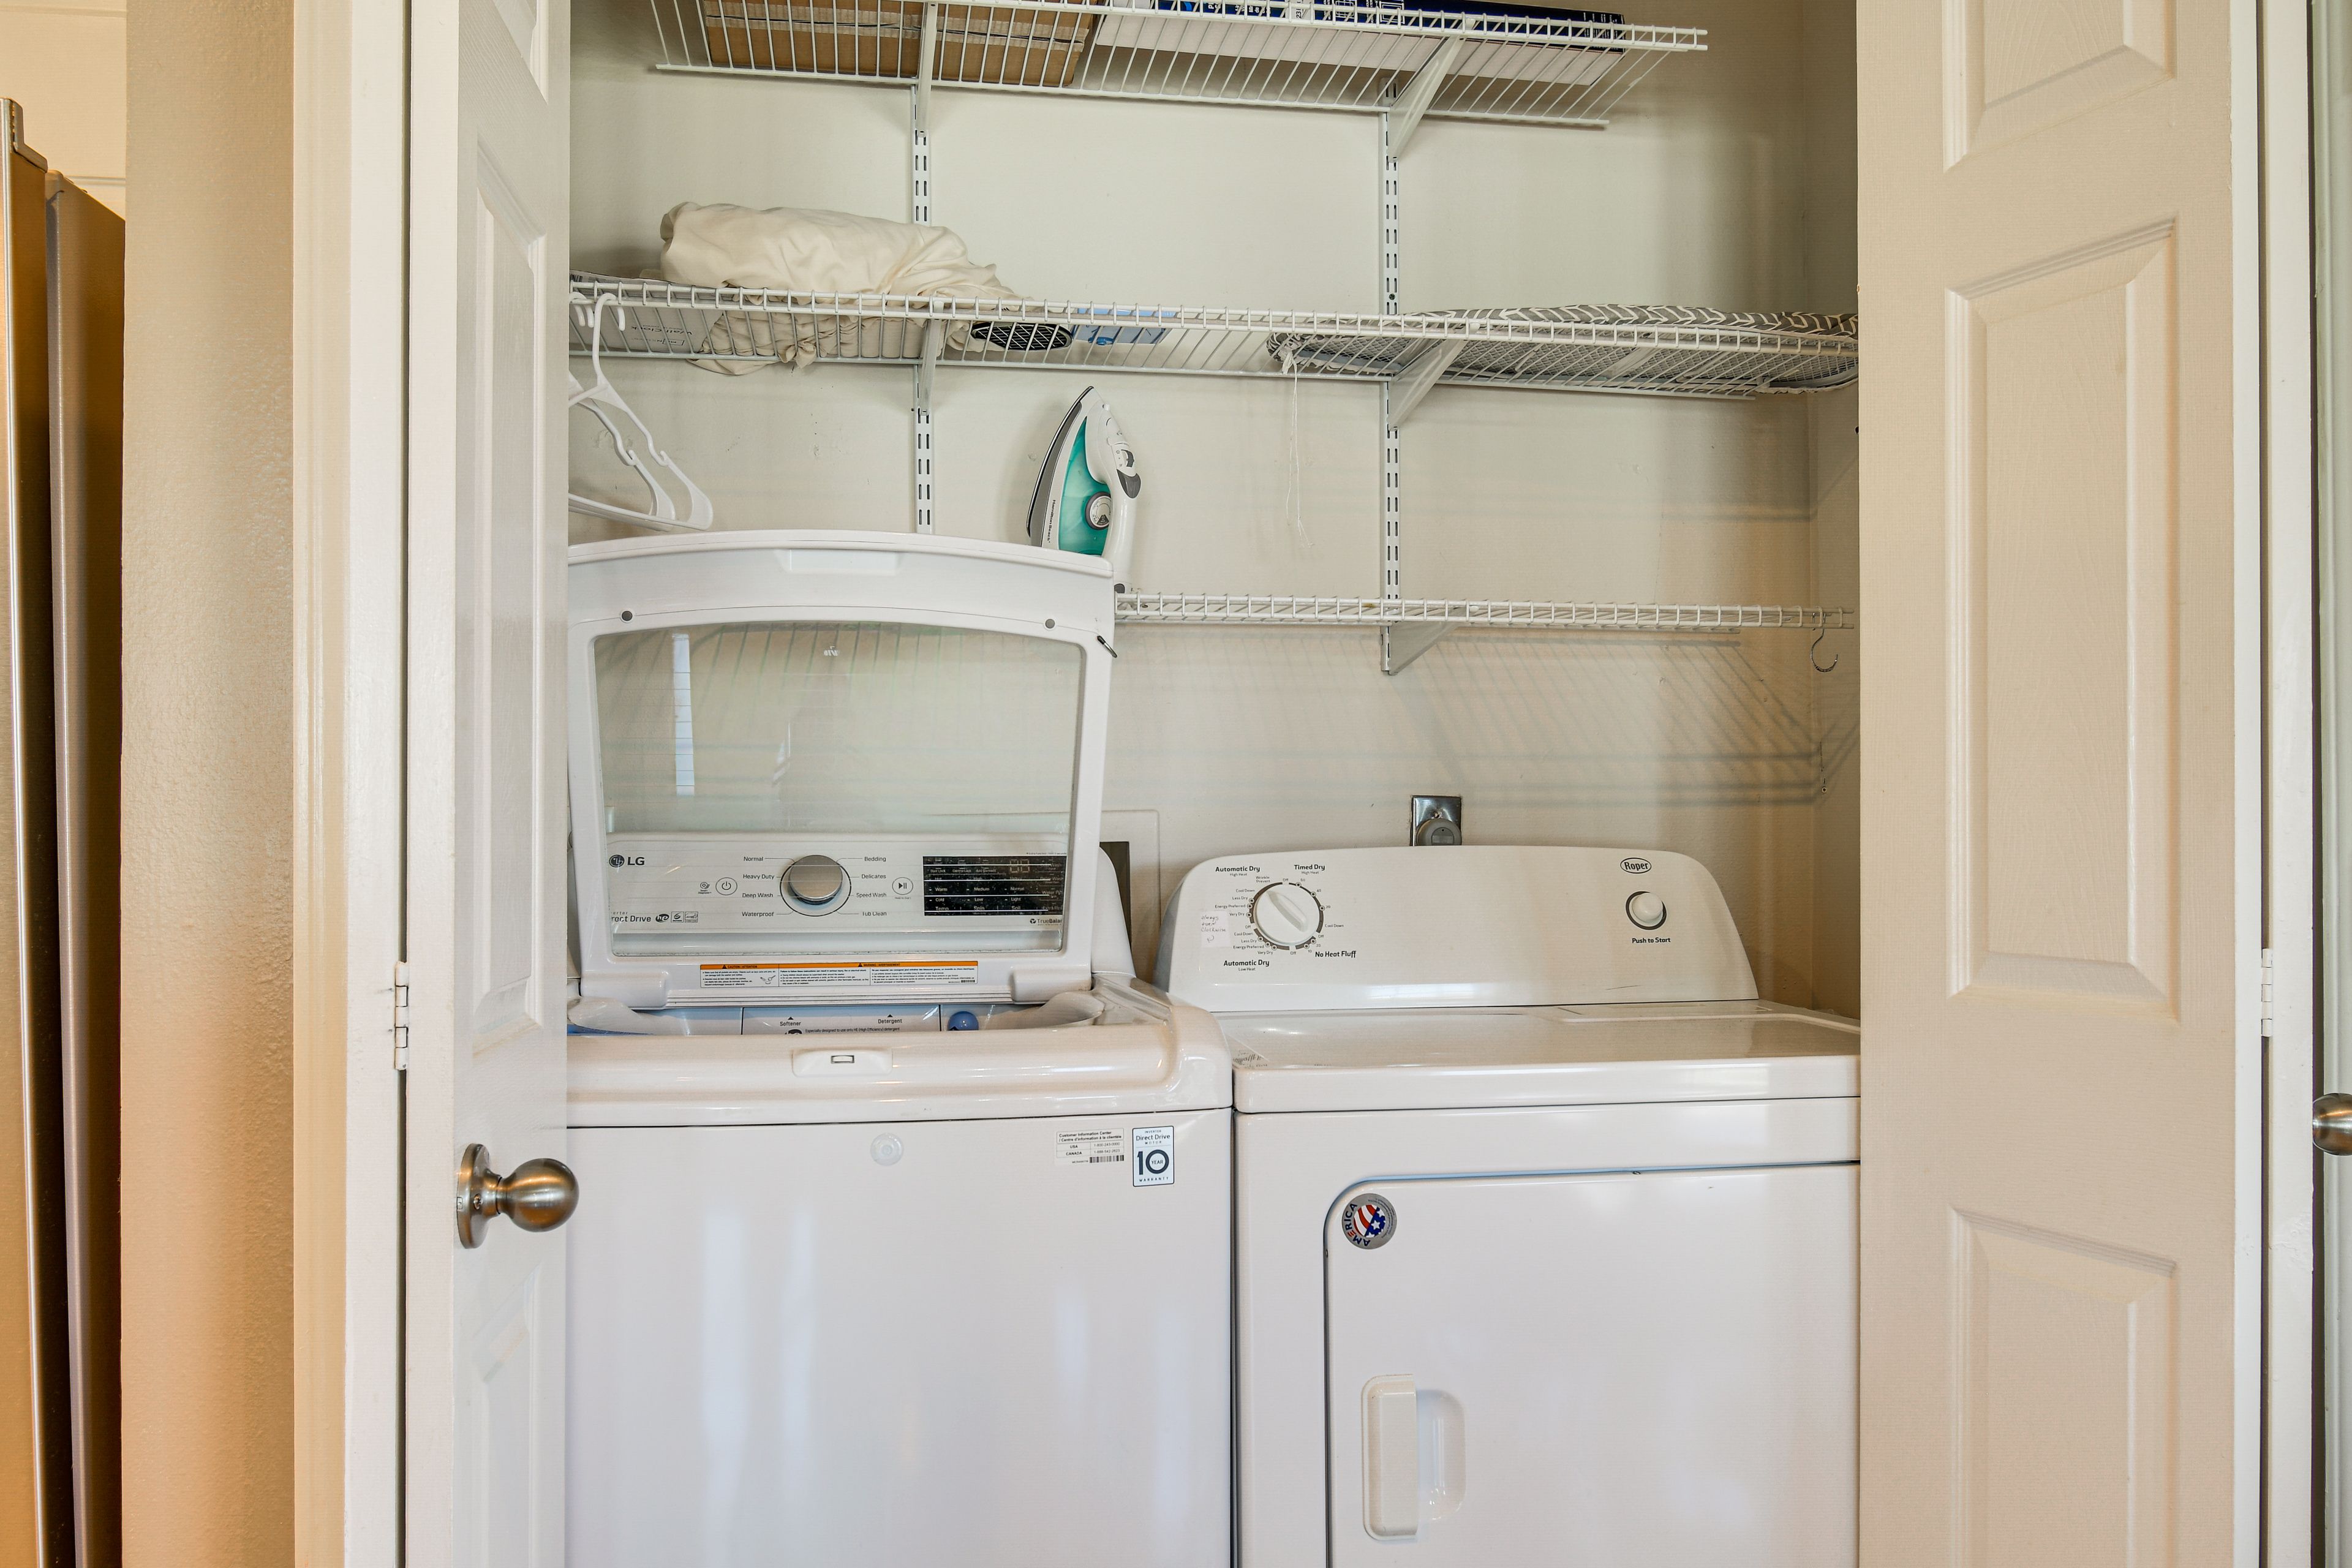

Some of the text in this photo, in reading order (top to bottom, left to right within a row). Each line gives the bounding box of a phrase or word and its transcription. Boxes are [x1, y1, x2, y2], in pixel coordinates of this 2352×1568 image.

[627, 857, 645, 865] LG
[1624, 862, 1648, 871] Roper
[1137, 1149, 1169, 1175] 10
[1344, 1203, 1371, 1246] AMERICA
